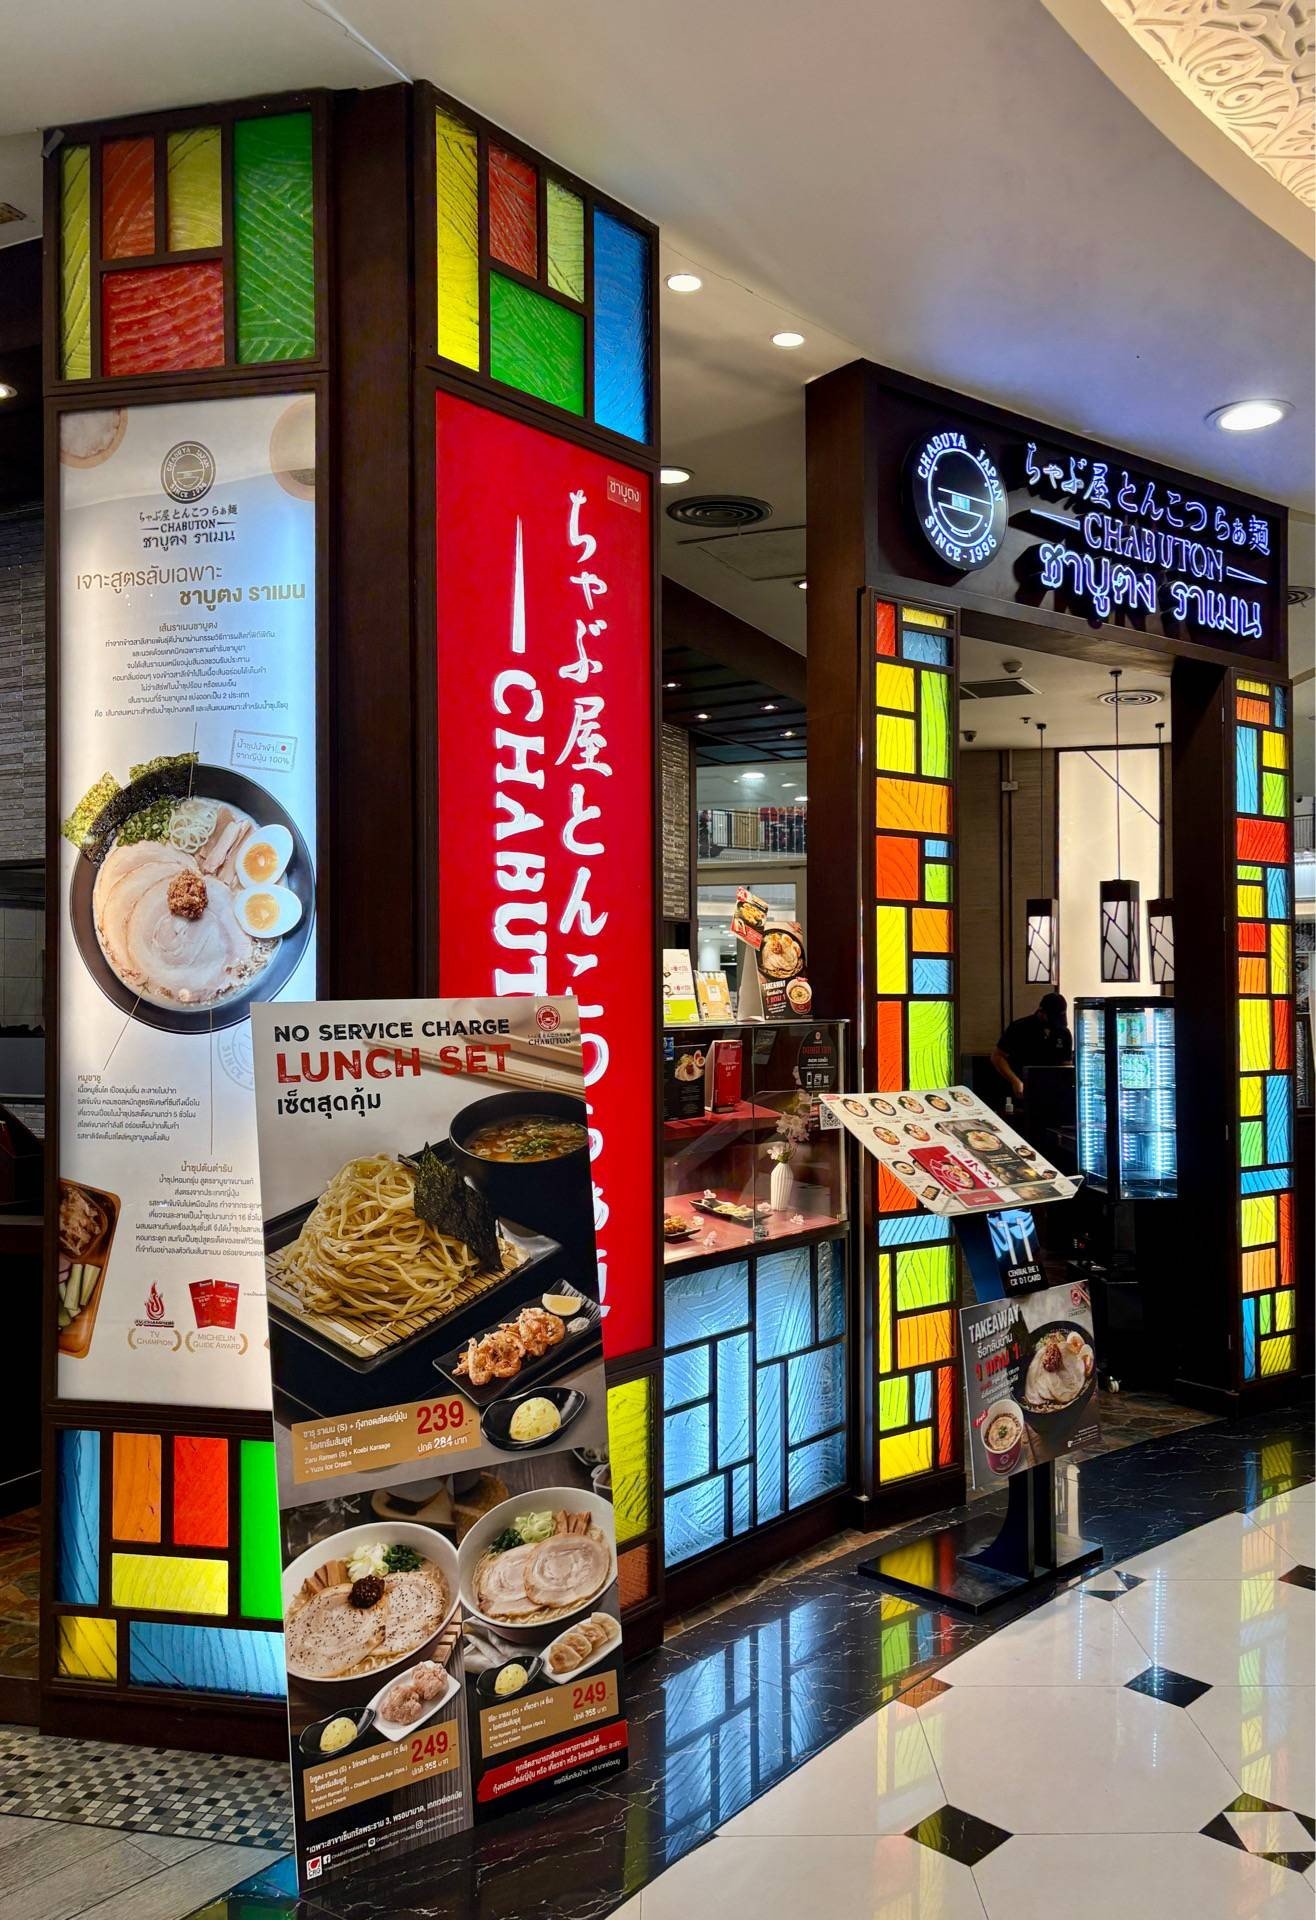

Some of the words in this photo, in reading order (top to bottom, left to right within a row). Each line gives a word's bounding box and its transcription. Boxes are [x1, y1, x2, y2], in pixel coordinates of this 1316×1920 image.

[918, 432, 967, 478] CHABUYA
[977, 449, 1003, 501] JAPAN
[143, 534, 187, 552] ชาบูตง
[194, 530, 236, 544] ราเมน
[160, 519, 216, 533] CHABUTON
[1084, 512, 1223, 582] CHABUTON
[77, 563, 223, 594] เจาะสูตรลับเฉพาะ
[1039, 543, 1156, 617] ชาบูตง
[1172, 580, 1262, 638] ราเมน
[180, 586, 242, 612] ชาบูตง
[249, 583, 305, 601] ราเมน
[274, 1024, 310, 1042] NO
[319, 1021, 413, 1041] SERVICE
[422, 1018, 510, 1037] CHARGE
[276, 1047, 421, 1084] LUNCH
[439, 1044, 511, 1075] SET
[277, 1087, 381, 1120] เซ็ตสุดคุ้ม
[198, 1333, 236, 1342] MICHELIN
[968, 1304, 1020, 1343] TAKEAWAY
[337, 1423, 348, 1434] (S)
